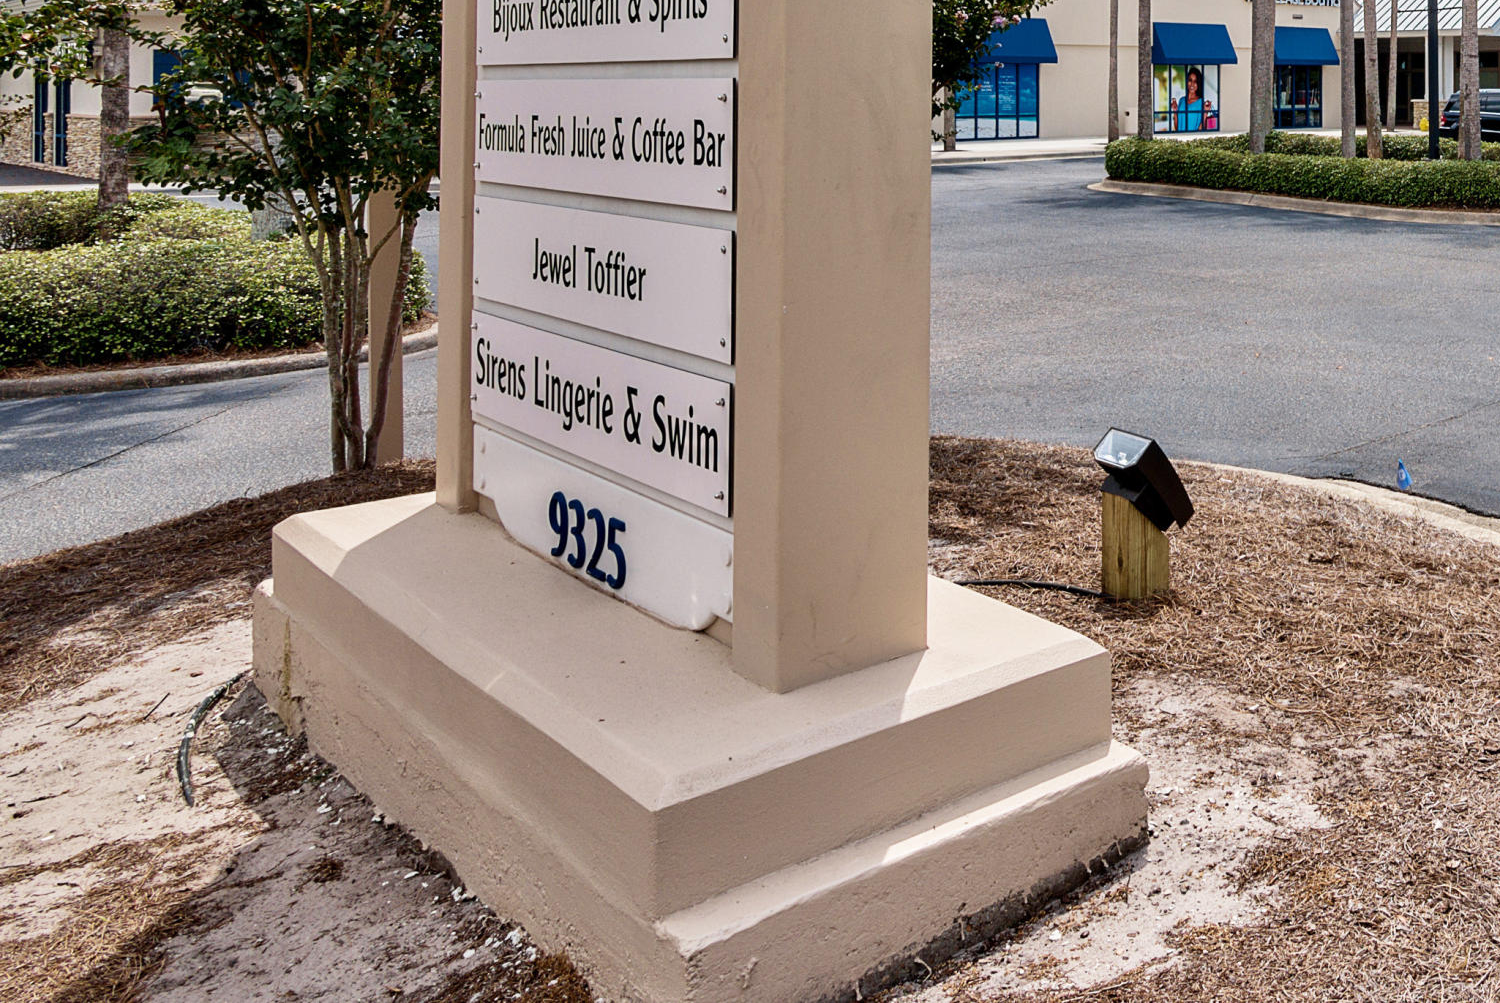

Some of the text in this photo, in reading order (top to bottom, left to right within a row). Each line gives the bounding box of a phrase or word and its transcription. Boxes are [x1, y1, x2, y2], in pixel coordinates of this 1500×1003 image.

[479, 113, 725, 168] Formula Fresh Juice & Coffee Bar
[532, 237, 647, 301] Jewel Toffier
[476, 338, 718, 473] Sirens Lingerie & Swim
[548, 491, 627, 590] 9325
